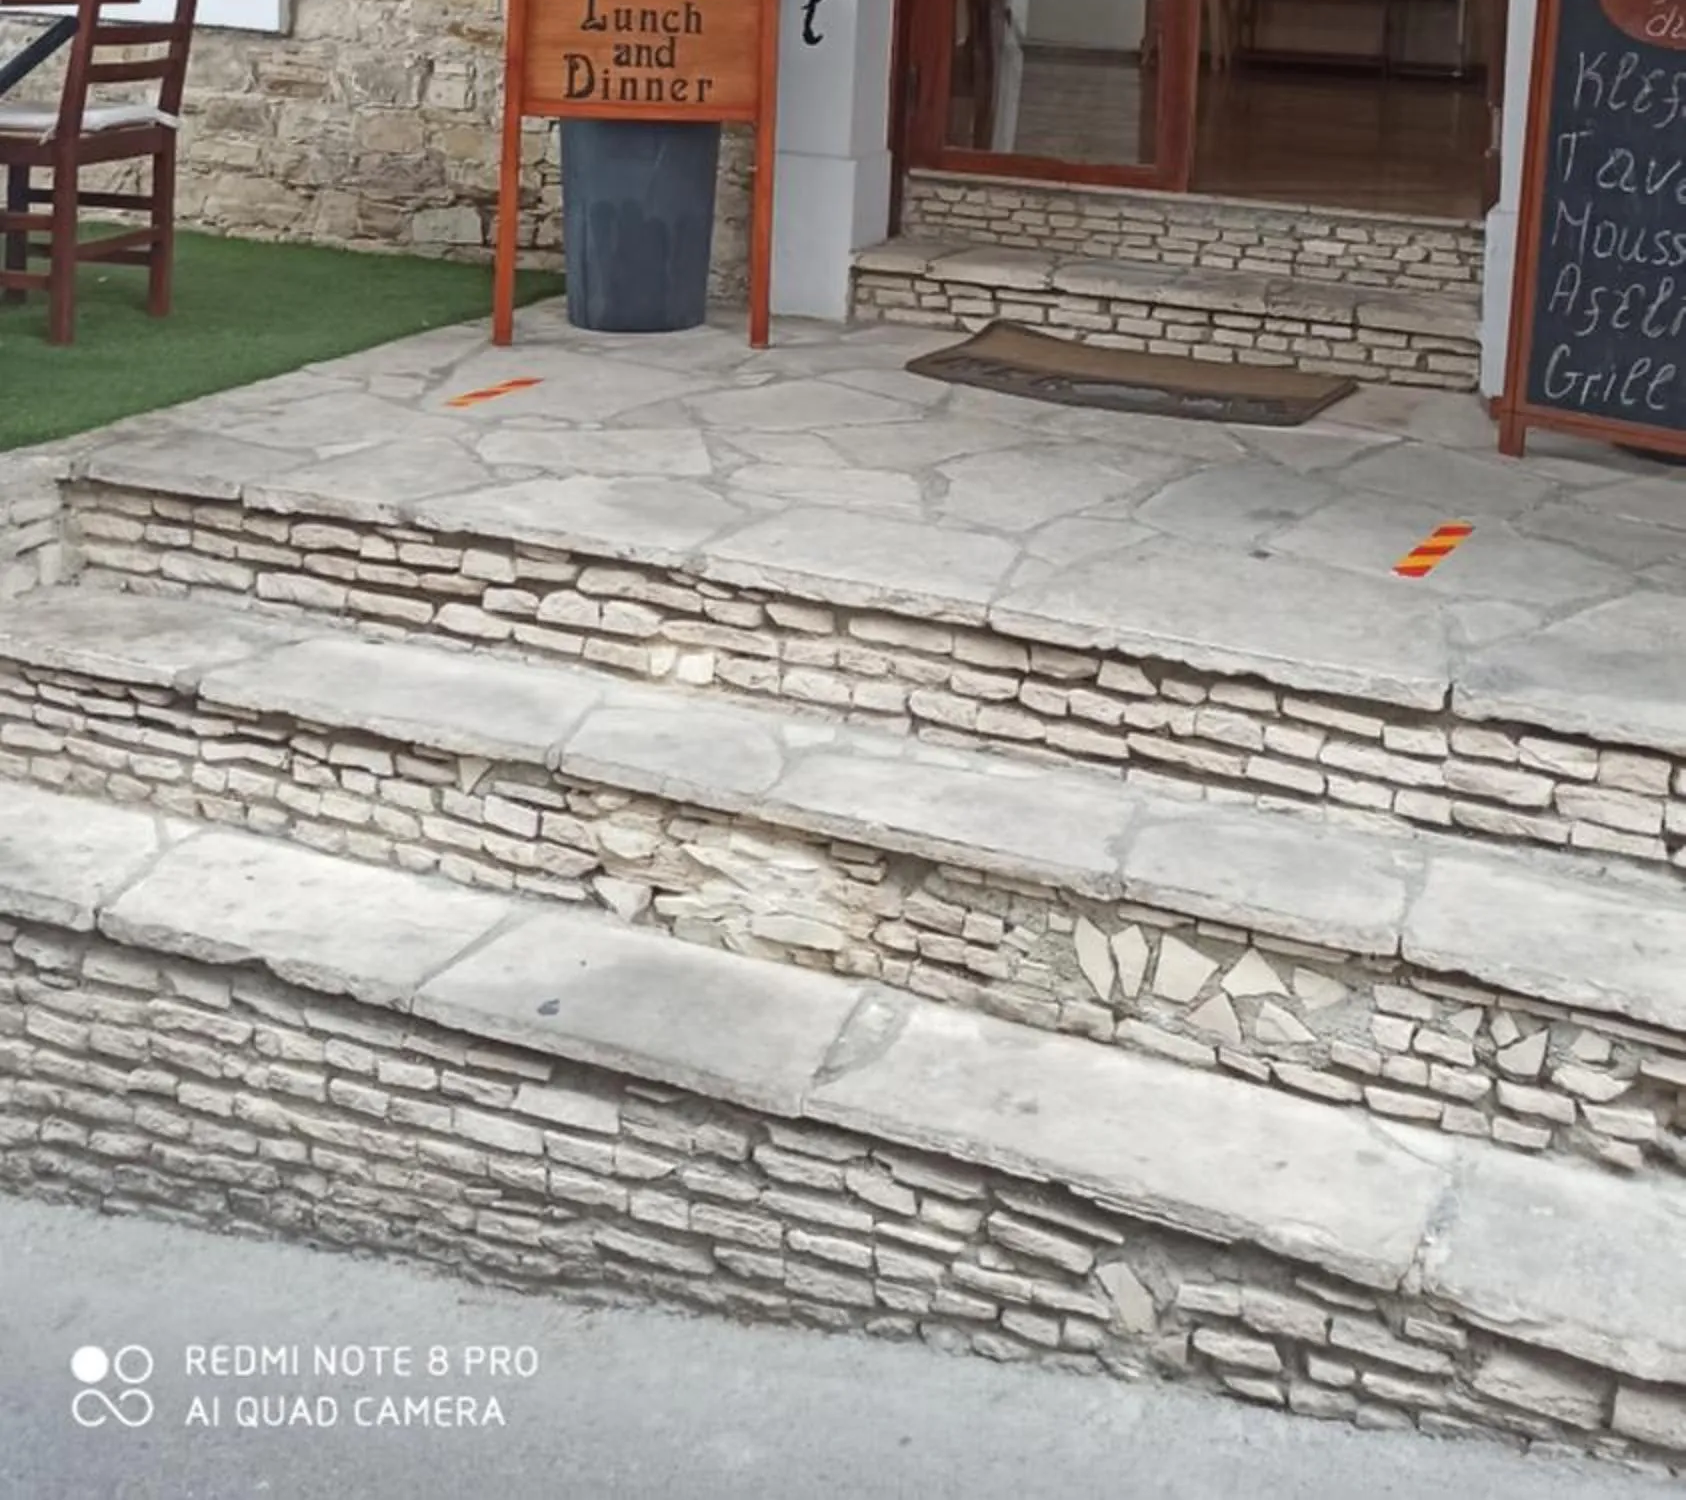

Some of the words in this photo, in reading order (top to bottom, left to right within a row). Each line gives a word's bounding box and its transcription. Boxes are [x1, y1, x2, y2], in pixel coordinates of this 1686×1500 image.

[562, 52, 714, 104] Dinner
[612, 36, 676, 69] and
[1573, 51, 1686, 129] Klef
[1544, 343, 1677, 411] Grill
